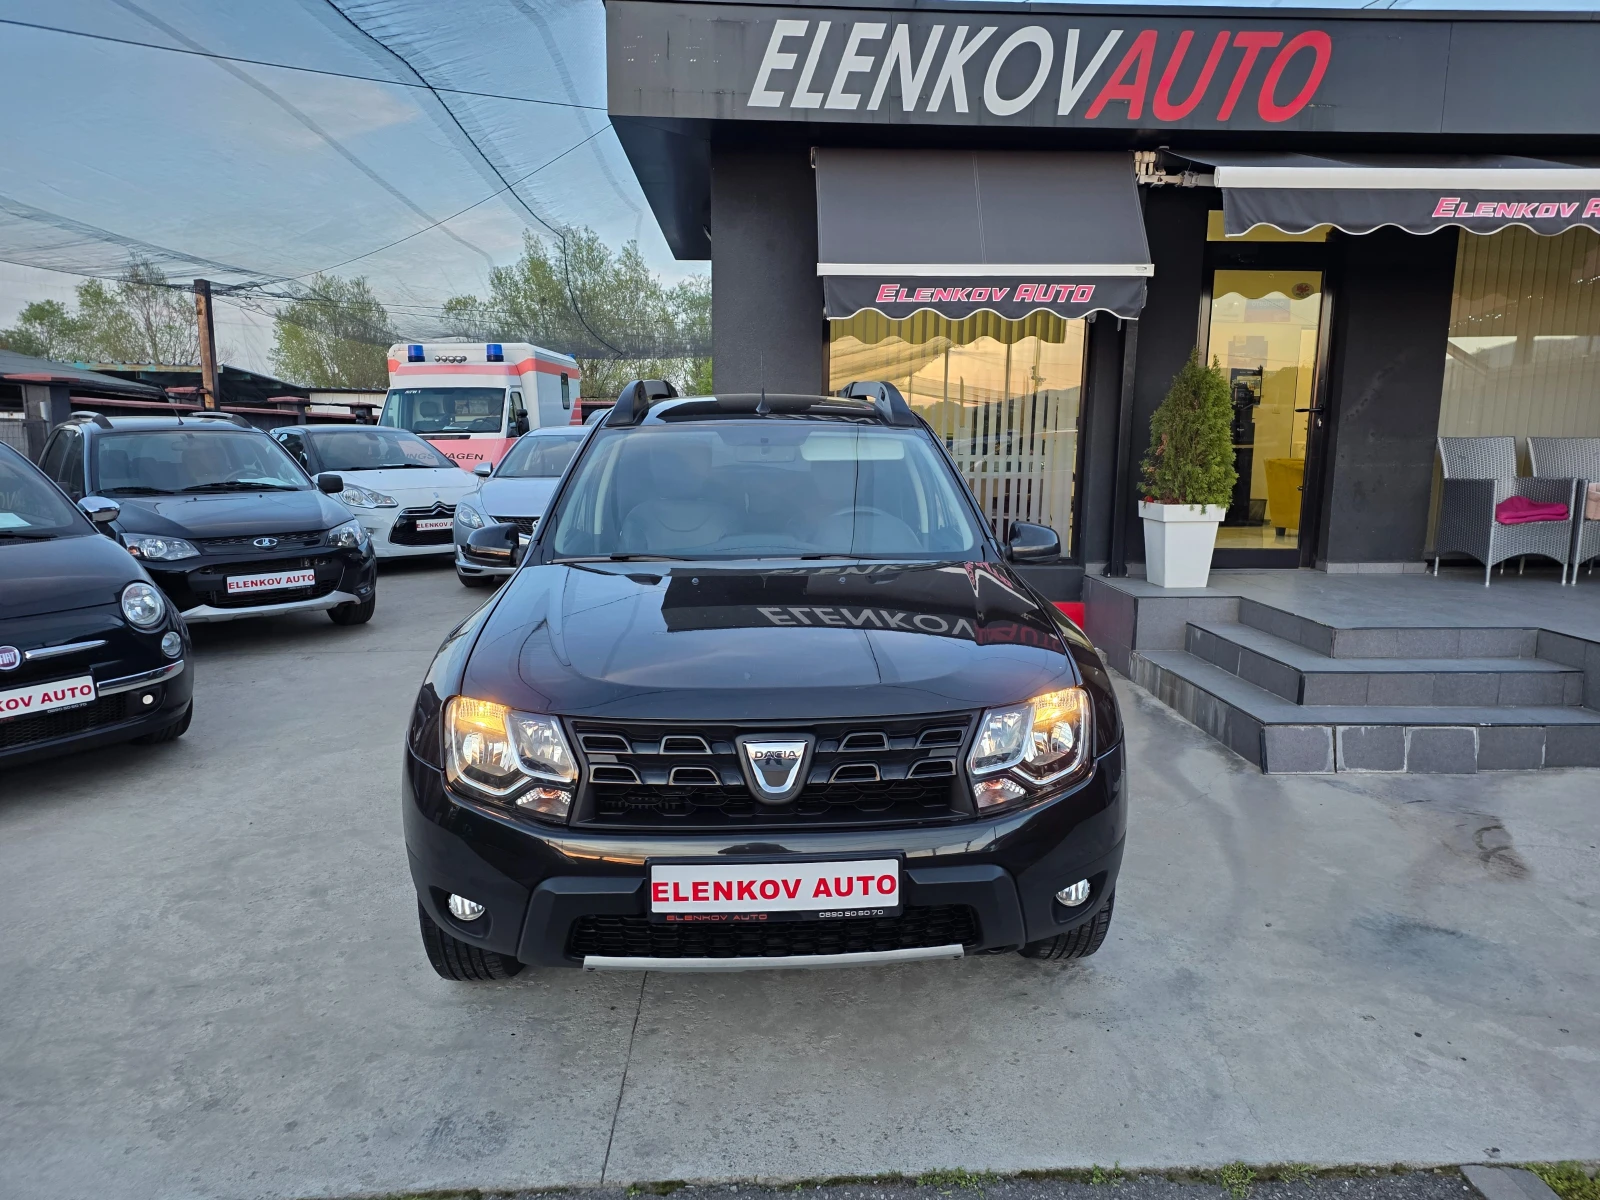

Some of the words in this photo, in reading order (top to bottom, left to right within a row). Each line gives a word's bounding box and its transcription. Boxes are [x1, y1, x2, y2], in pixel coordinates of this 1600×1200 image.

[1432, 197, 1580, 219] ELENKOV
[875, 284, 1010, 303] ELENKOV
[1013, 284, 1096, 303] AUTO
[228, 577, 282, 590] ELENKOV
[285, 574, 316, 584] AUTO
[41, 685, 92, 704] AUTO
[754, 750, 797, 759] DACIA
[652, 879, 802, 902] ELENKOV
[812, 874, 897, 898] AUTO
